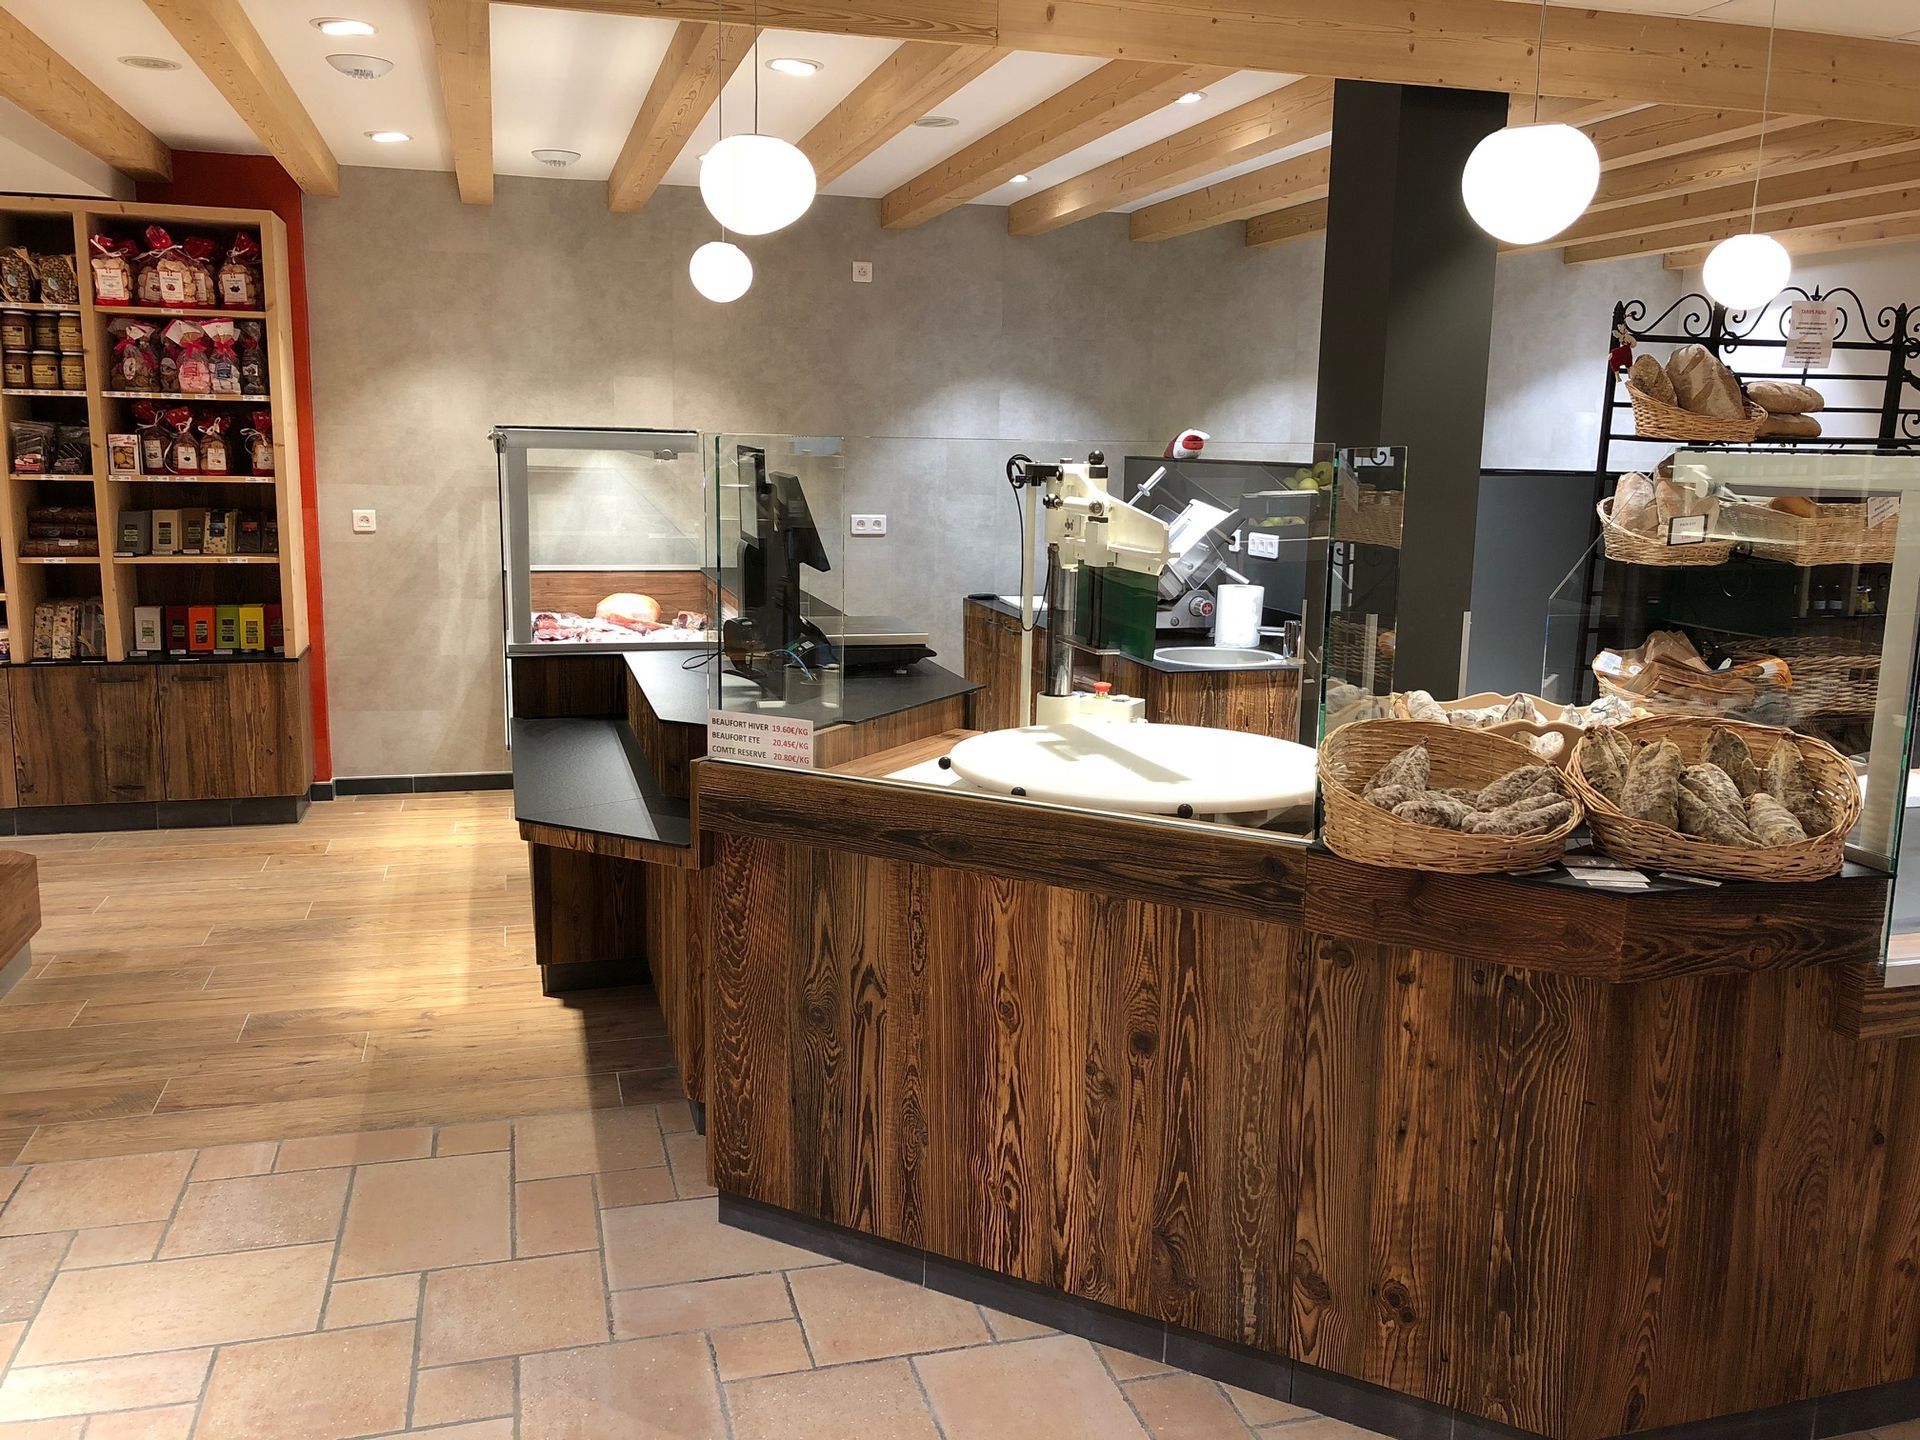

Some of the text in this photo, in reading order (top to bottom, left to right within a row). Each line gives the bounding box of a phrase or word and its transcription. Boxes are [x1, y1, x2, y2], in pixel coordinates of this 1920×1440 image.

[711, 717, 808, 736] BEAUFORT HIVER 19.60€/KG
[711, 732, 809, 750] BEAUFORT ETE 20.45€/KG
[712, 745, 809, 764] COMTE RESERVE 20.80€/KG
